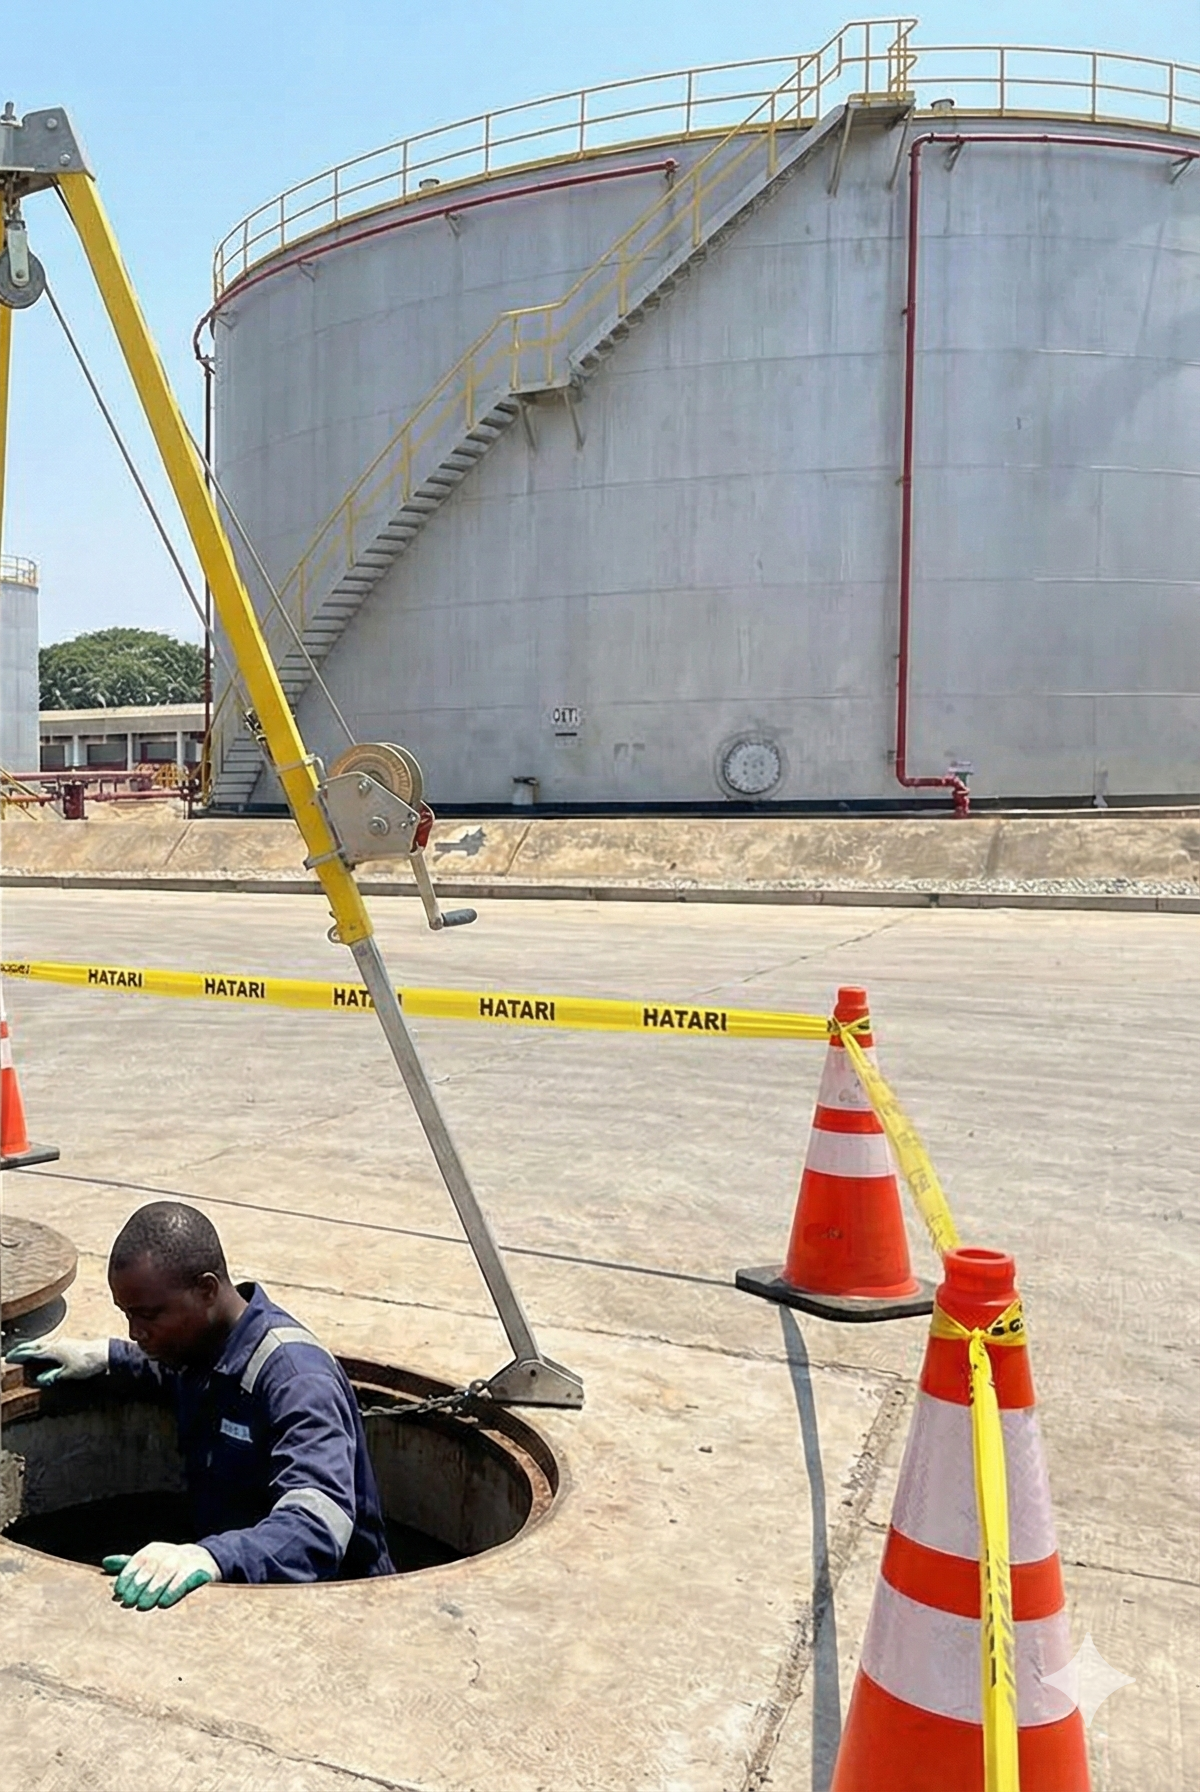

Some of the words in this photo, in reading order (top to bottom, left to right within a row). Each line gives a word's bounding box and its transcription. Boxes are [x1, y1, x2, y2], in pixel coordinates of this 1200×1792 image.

[88, 969, 142, 988] HATARI
[204, 977, 265, 998] HATARI
[333, 987, 402, 1008] HATI
[480, 998, 555, 1020] HATARI
[643, 1008, 727, 1031] HATARI
